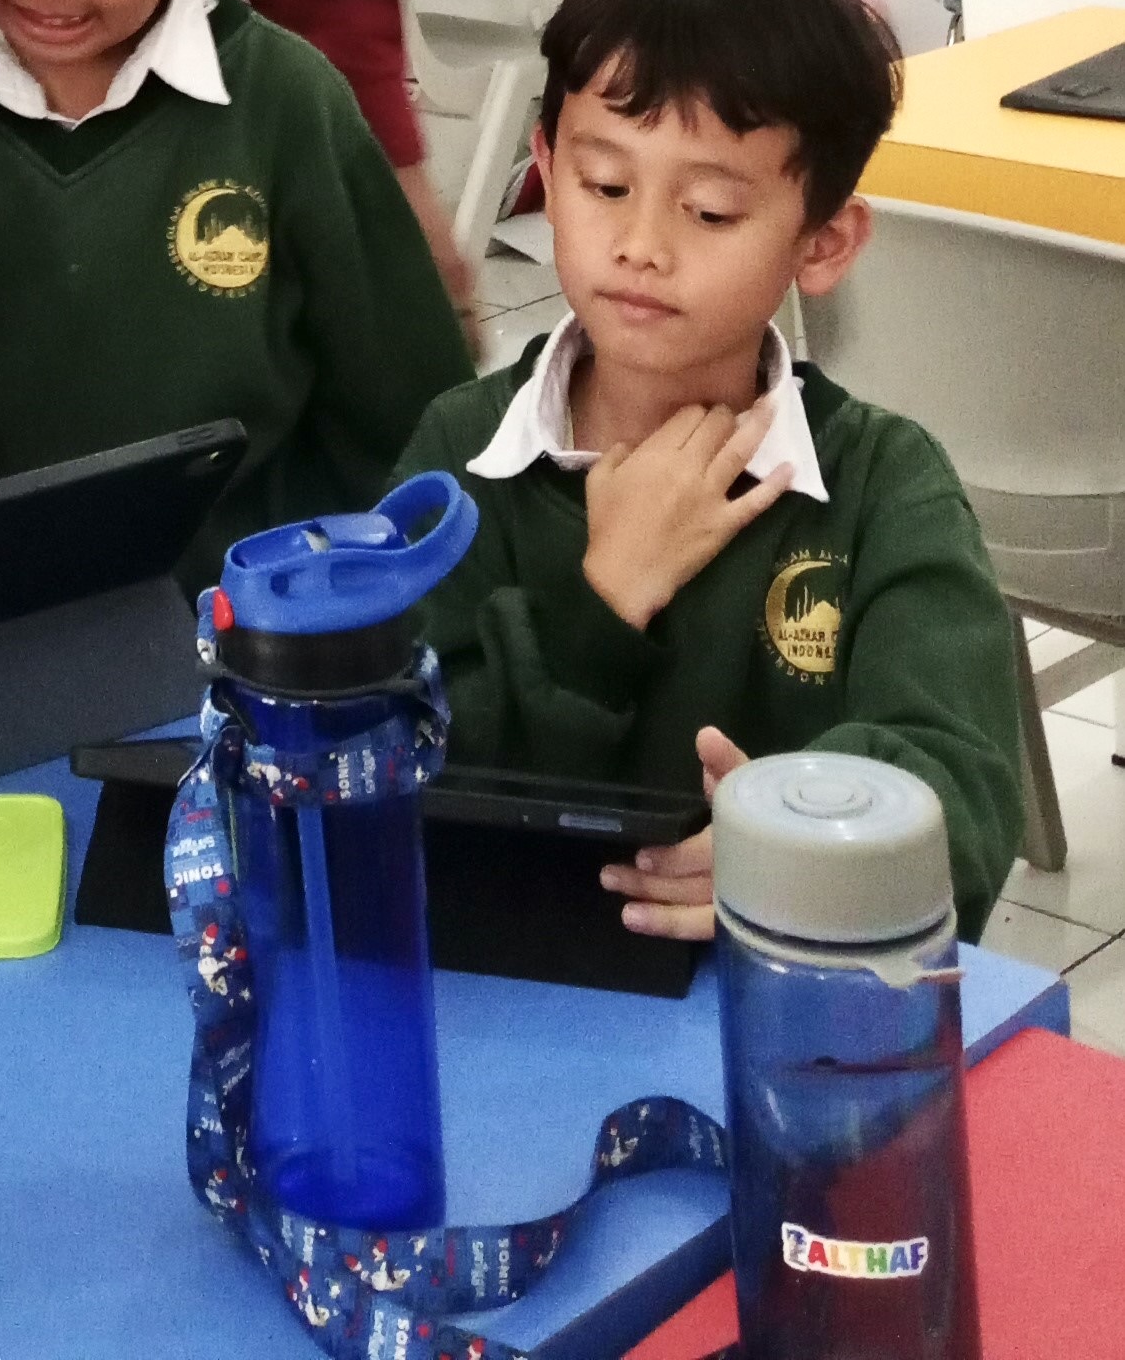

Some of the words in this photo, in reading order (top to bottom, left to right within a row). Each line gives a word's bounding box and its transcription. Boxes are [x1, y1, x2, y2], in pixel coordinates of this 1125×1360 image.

[173, 862, 225, 887] SONIC
[498, 1238, 510, 1297] SONIC
[807, 1240, 925, 1274] ALTHAF
